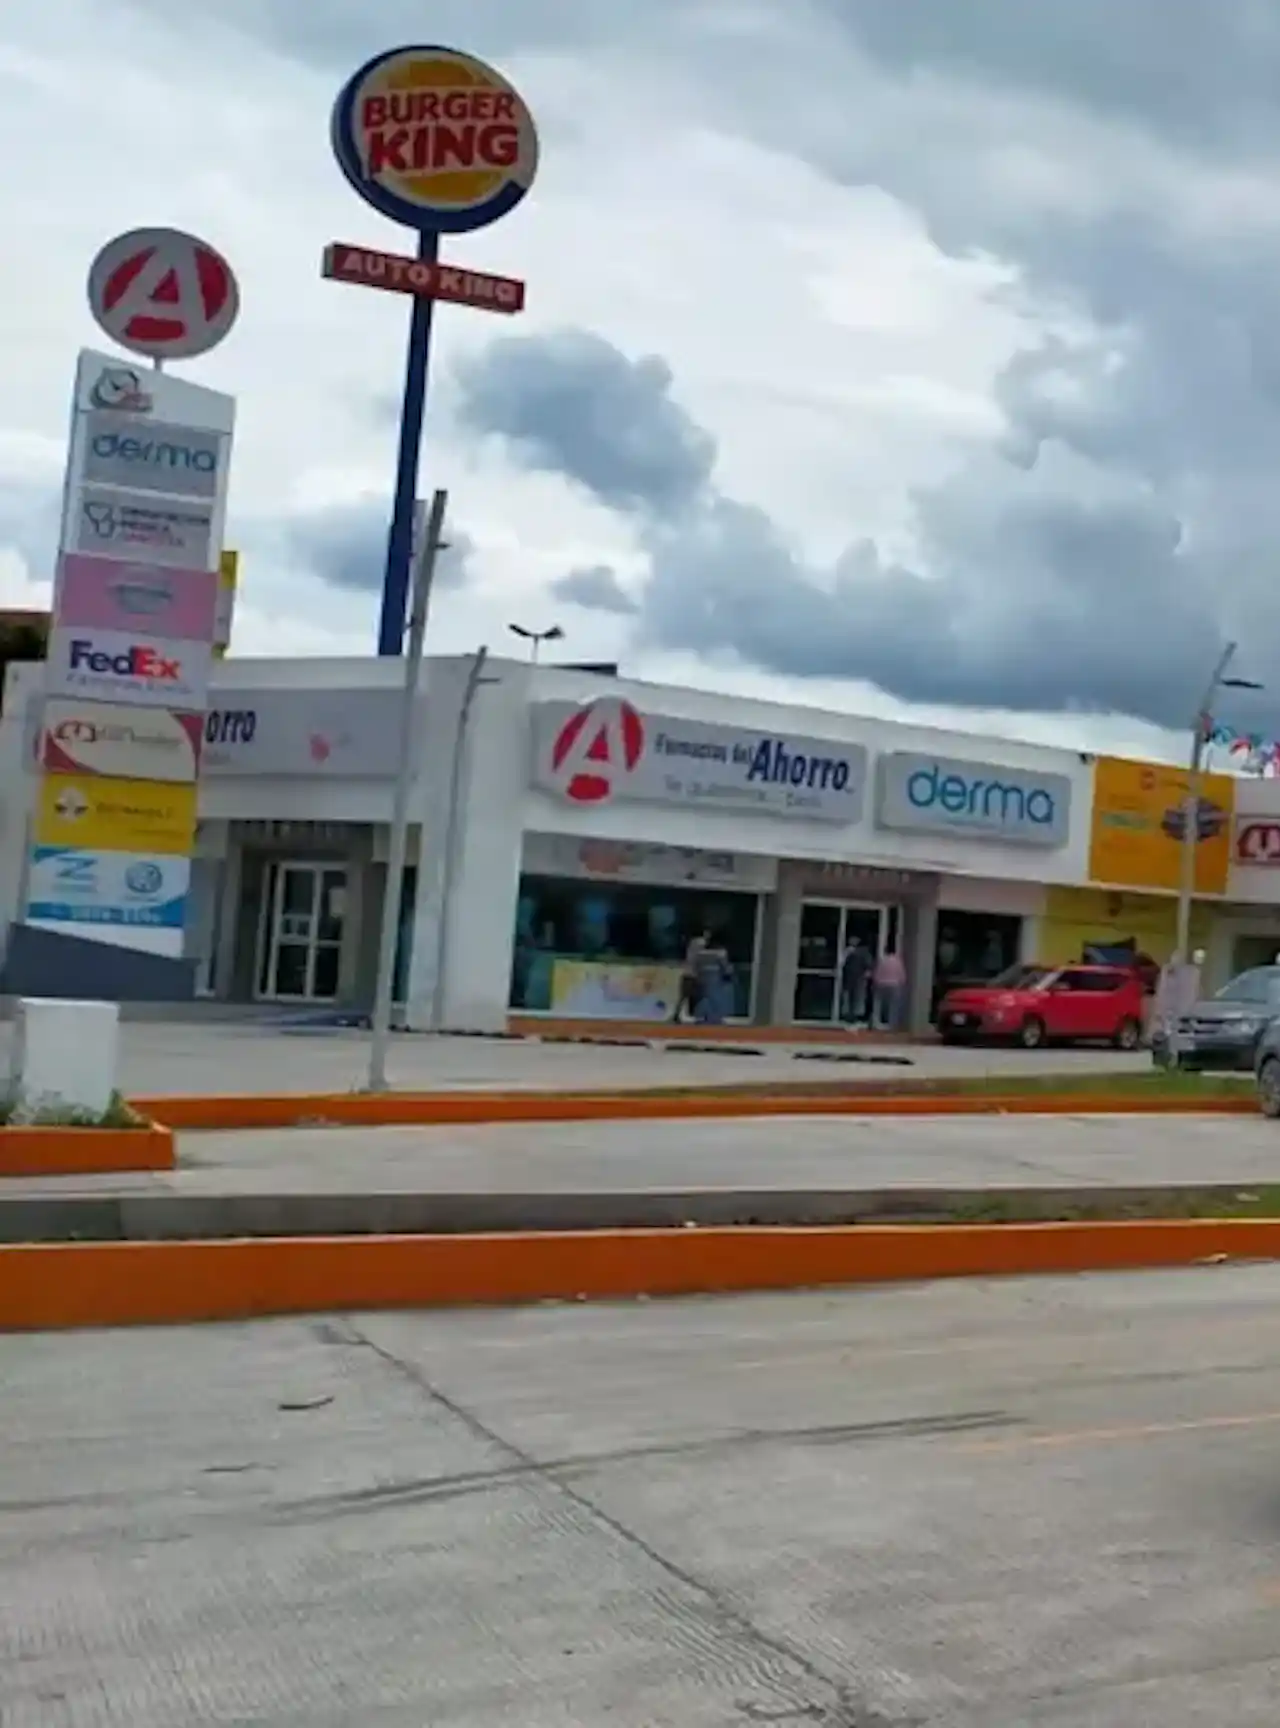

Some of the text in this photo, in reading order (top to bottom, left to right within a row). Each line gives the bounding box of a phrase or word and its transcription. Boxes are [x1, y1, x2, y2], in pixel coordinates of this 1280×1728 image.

[362, 92, 516, 129] BURGER
[369, 125, 519, 175] KING
[342, 252, 519, 303] AUTO KING
[91, 434, 217, 473] derma
[69, 640, 181, 681] FedEx
[204, 709, 257, 745] orro
[745, 739, 851, 791] Ahorro
[906, 764, 1055, 824] derma
